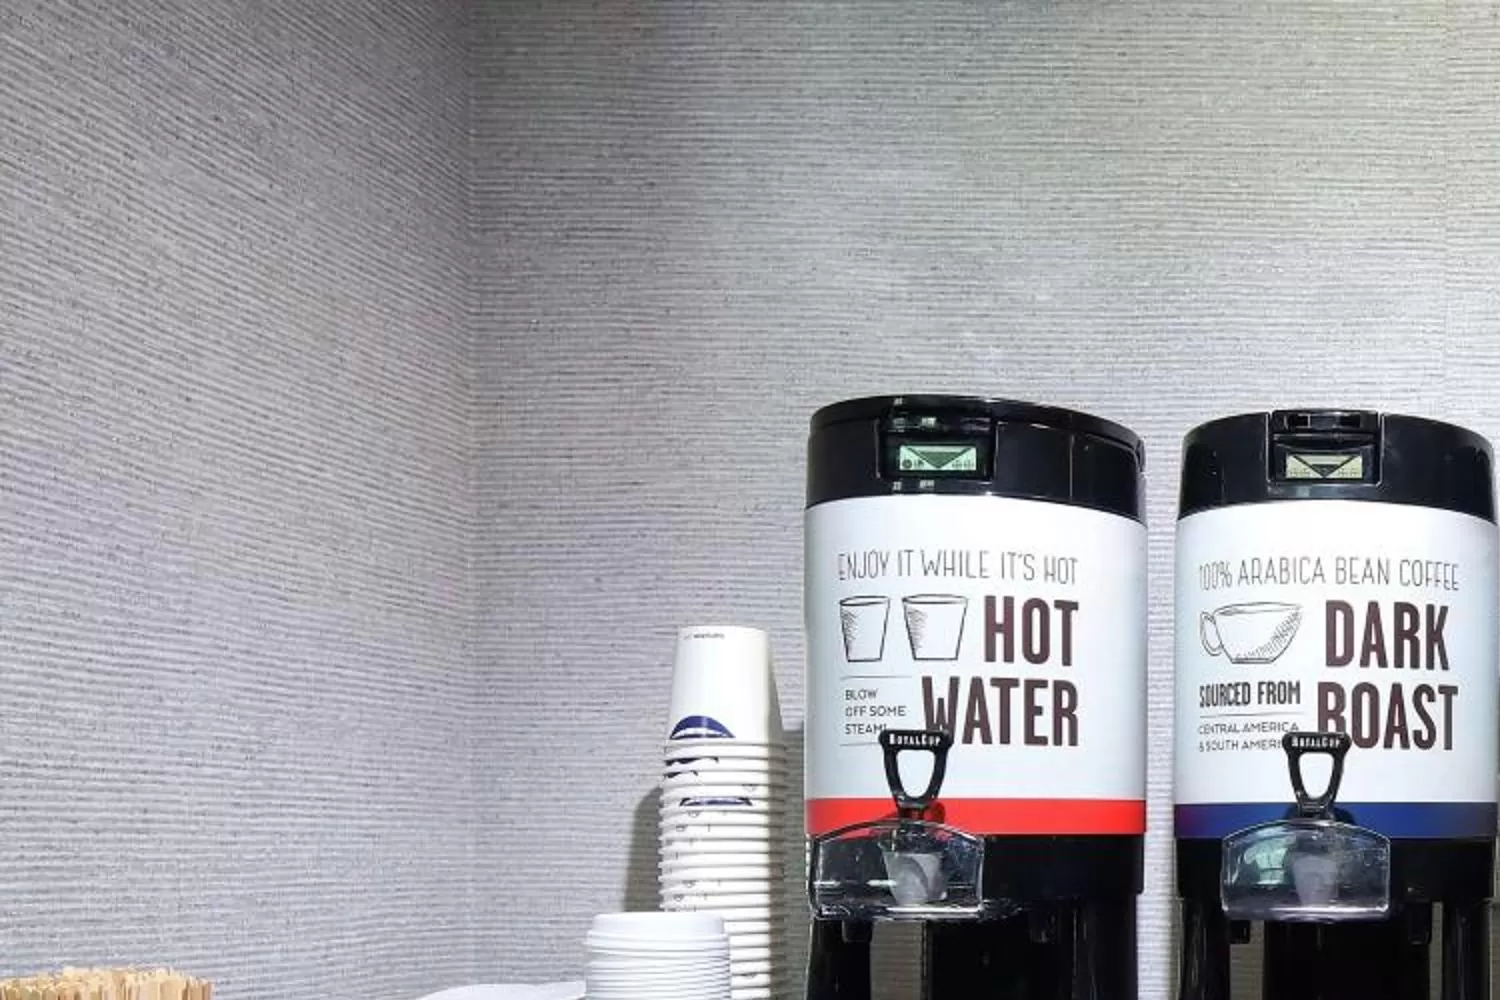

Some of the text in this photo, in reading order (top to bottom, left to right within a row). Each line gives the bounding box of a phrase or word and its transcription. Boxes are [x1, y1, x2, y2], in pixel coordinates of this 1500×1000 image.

[837, 549, 1079, 585] ENJOY IT WHILE IT'S HOT
[1199, 556, 1460, 591] 100% ARABICA BEAN COFFEE
[983, 595, 1080, 667] HOT
[1325, 599, 1450, 671] DARK
[844, 689, 878, 701] BLOW
[845, 705, 907, 717] OFF SOME
[921, 675, 1079, 747] WATER
[1199, 679, 1301, 708] SOURCED FROM
[1198, 721, 1300, 735] CENTRAL AMERICA
[1317, 681, 1459, 751] ROAST
[1206, 740, 1239, 751] SOUTH
[1241, 739, 1282, 751] AMERI
